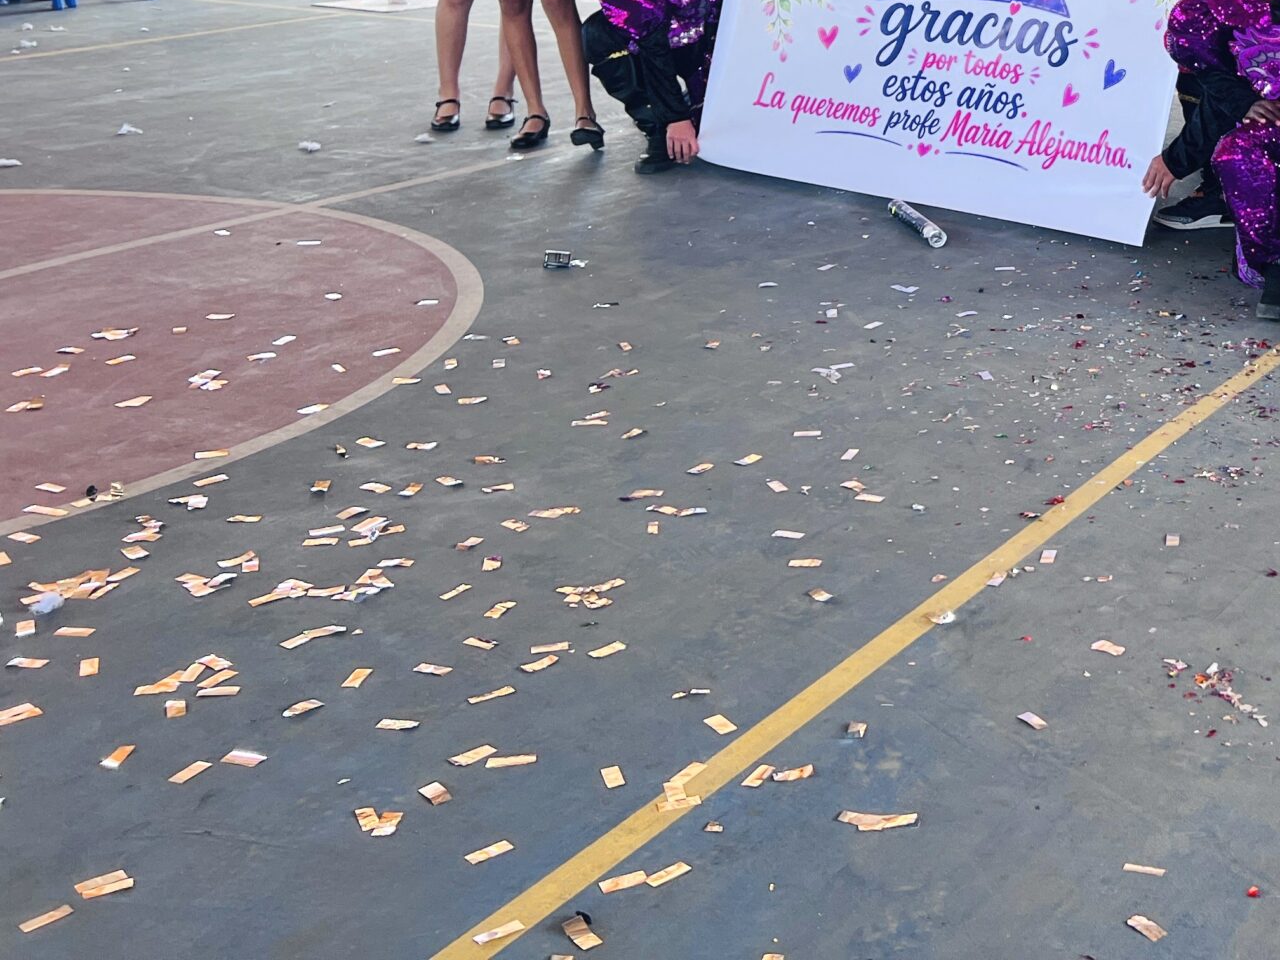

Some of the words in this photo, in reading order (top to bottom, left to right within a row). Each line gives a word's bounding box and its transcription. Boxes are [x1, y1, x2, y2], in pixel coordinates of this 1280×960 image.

[875, 1, 1078, 67] gracias
[882, 69, 952, 107] estos
[957, 83, 1027, 119] años.
[921, 51, 958, 72] por
[963, 50, 1024, 84] todos
[753, 72, 787, 109] La
[790, 95, 881, 127] queremos
[883, 109, 941, 139] profe
[940, 109, 1013, 149] María
[1014, 120, 1131, 169] Alejandra.
